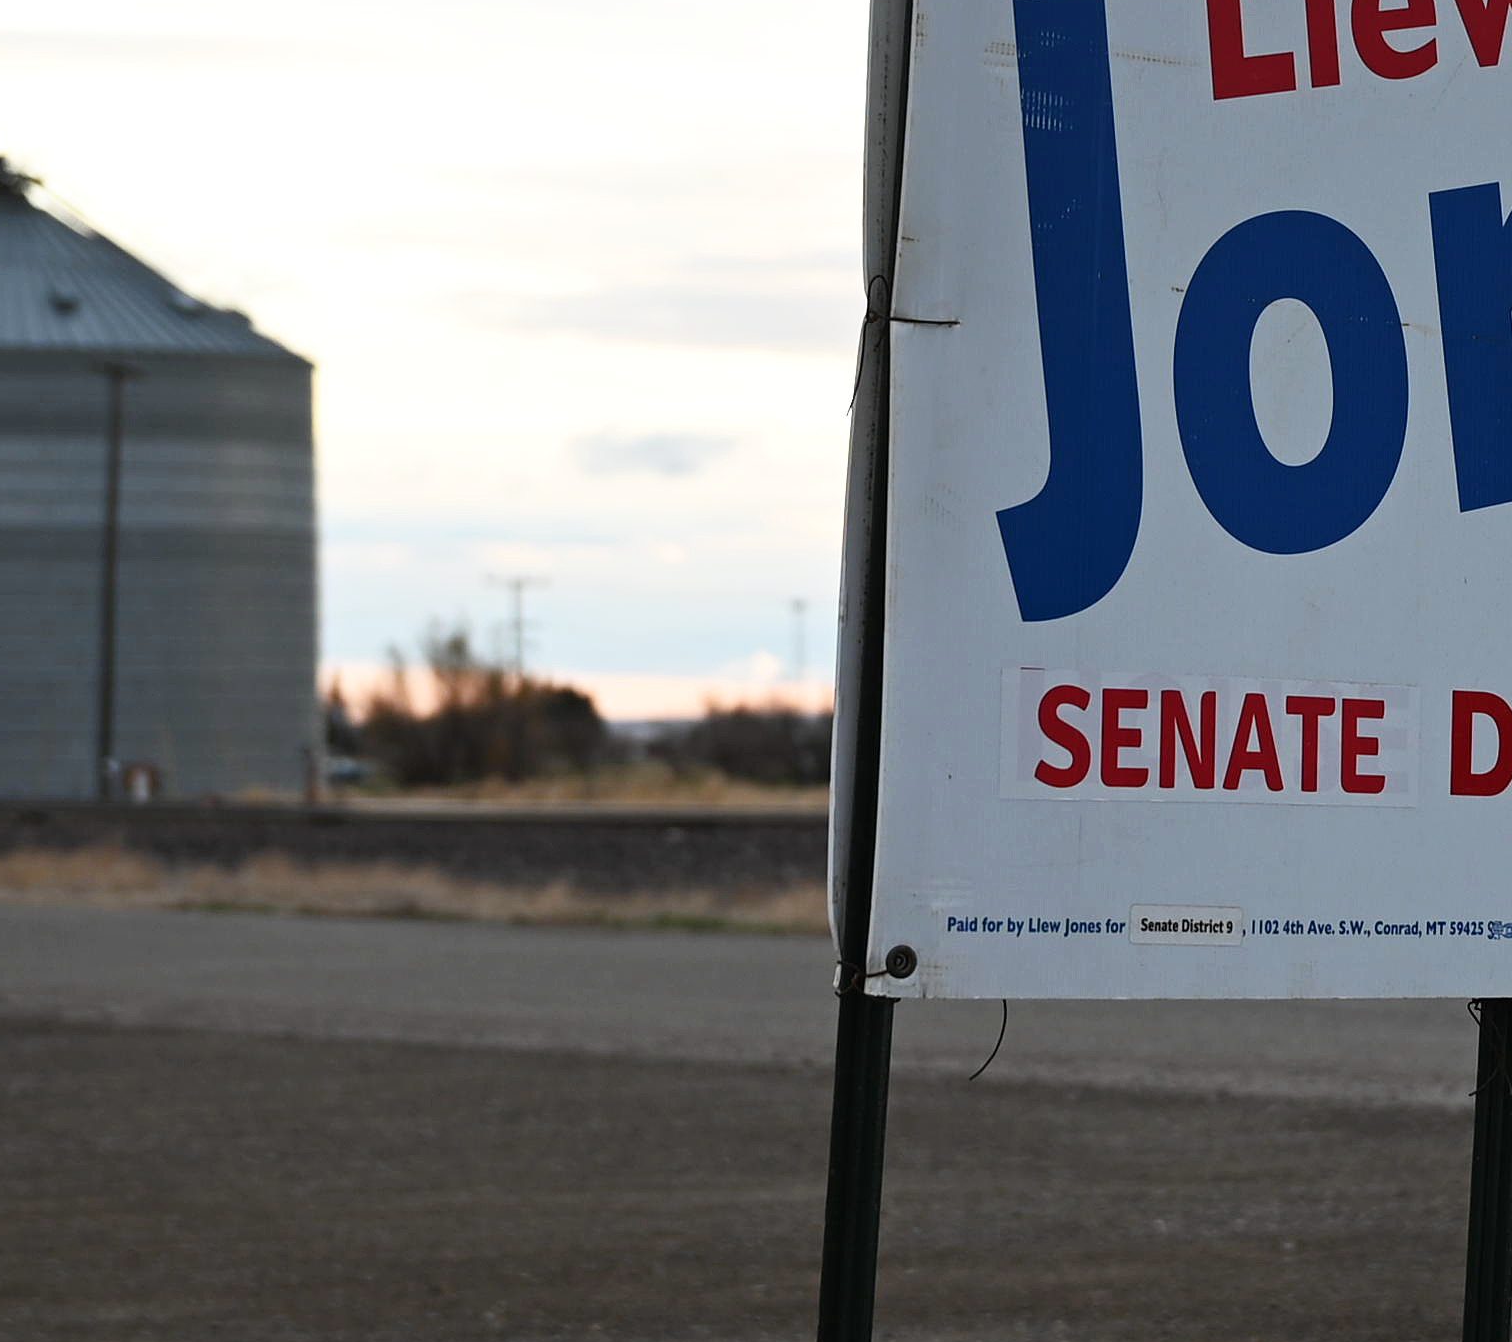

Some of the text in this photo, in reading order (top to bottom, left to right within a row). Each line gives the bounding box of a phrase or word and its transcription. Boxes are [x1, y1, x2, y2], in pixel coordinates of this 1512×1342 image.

[1034, 684, 1386, 794] SENATE
[947, 916, 978, 933] Paid
[982, 917, 1003, 933] for
[1007, 917, 1024, 937] by
[1028, 917, 1060, 934] Llew
[1064, 918, 1101, 938] Jones
[1105, 918, 1126, 934] for
[1140, 918, 1179, 933] Senate
[1181, 919, 1222, 934] District
[1225, 920, 1233, 934] 9
[1251, 920, 1279, 935] 1102
[1283, 920, 1304, 935] 4th
[1307, 920, 1335, 935] Ave.
[1338, 920, 1371, 937] S.W.,
[1374, 920, 1423, 938] Conrad,
[1426, 921, 1446, 935] MT
[1449, 920, 1484, 935] 59425
